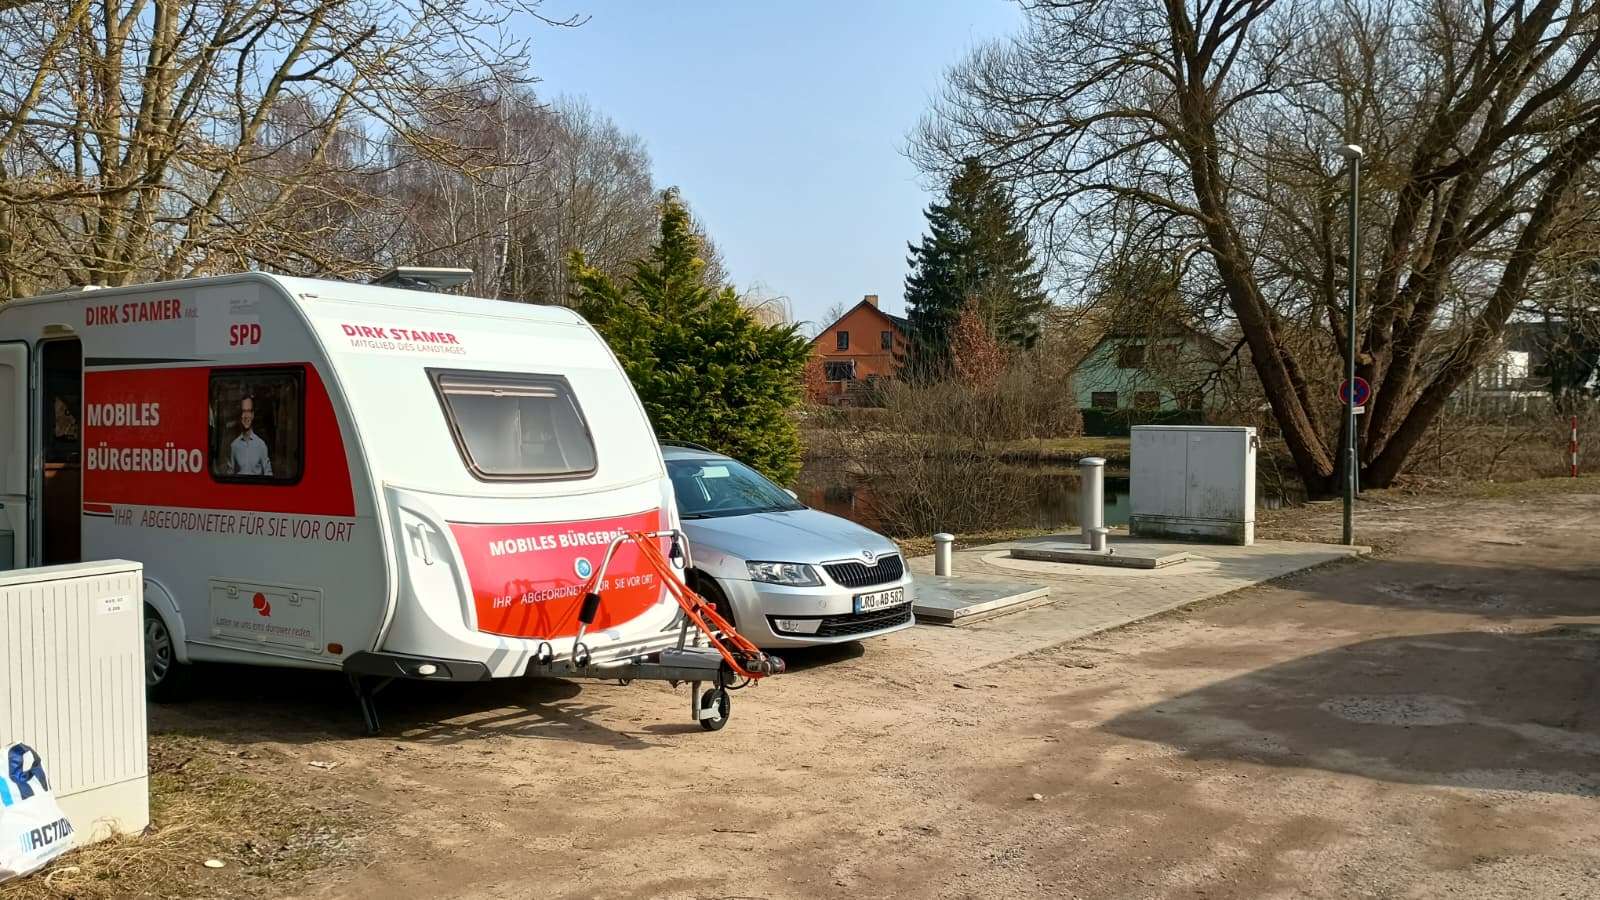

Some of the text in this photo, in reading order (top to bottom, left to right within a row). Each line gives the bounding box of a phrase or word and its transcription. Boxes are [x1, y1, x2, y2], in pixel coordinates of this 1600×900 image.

[85, 304, 118, 326] DIRK
[121, 299, 182, 323] STAMER
[229, 323, 262, 346] SPD
[341, 323, 460, 345] DIRK STAMER
[350, 339, 395, 351] MITGLIED
[398, 342, 417, 352] DES
[87, 402, 161, 427] MOBILES
[87, 442, 203, 474] BÜRGERBÜRO
[114, 508, 356, 543] IHR ABGEORDNETER FÜR SIE VOR ORT
[489, 527, 644, 556] MOBILES BÜRGERBÜ
[493, 595, 512, 608] IHR
[520, 582, 594, 604] ABGEORDNET
[615, 577, 625, 591] SIE
[626, 574, 641, 589] VOR
[641, 573, 655, 586] ORT
[861, 590, 903, 609] LRO AB 582
[30, 816, 74, 850] ACTION
